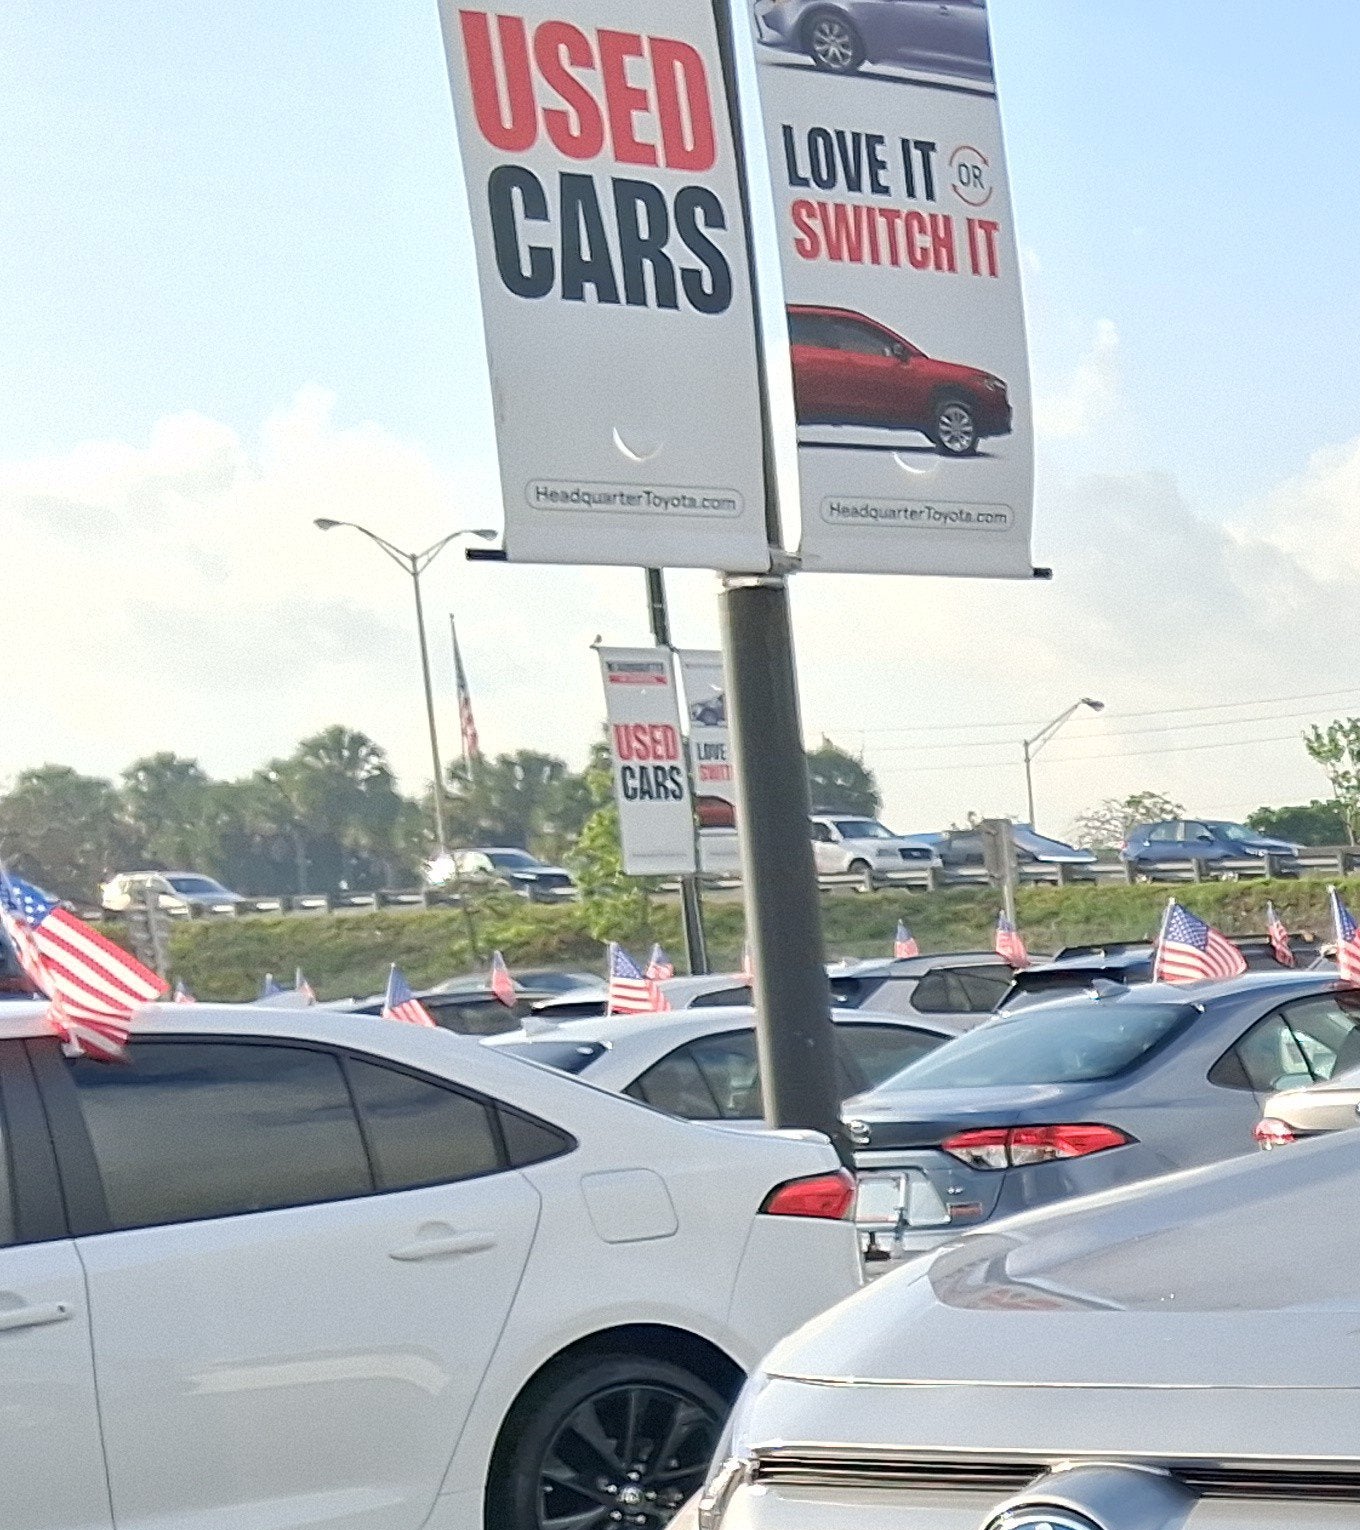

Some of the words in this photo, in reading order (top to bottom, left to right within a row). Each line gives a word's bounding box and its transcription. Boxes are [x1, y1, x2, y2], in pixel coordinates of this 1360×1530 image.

[459, 9, 717, 172] USED
[781, 124, 891, 196] LOVE
[900, 137, 937, 201] IT
[958, 163, 986, 189] OR
[488, 164, 732, 314] CARS
[791, 199, 957, 273] SWITCH
[966, 217, 999, 278] IT
[536, 486, 737, 511] HeadquarterToyota.com
[829, 502, 1008, 524] HeadquarterToyota.com
[614, 724, 678, 760] USED
[621, 765, 684, 800] CARS
